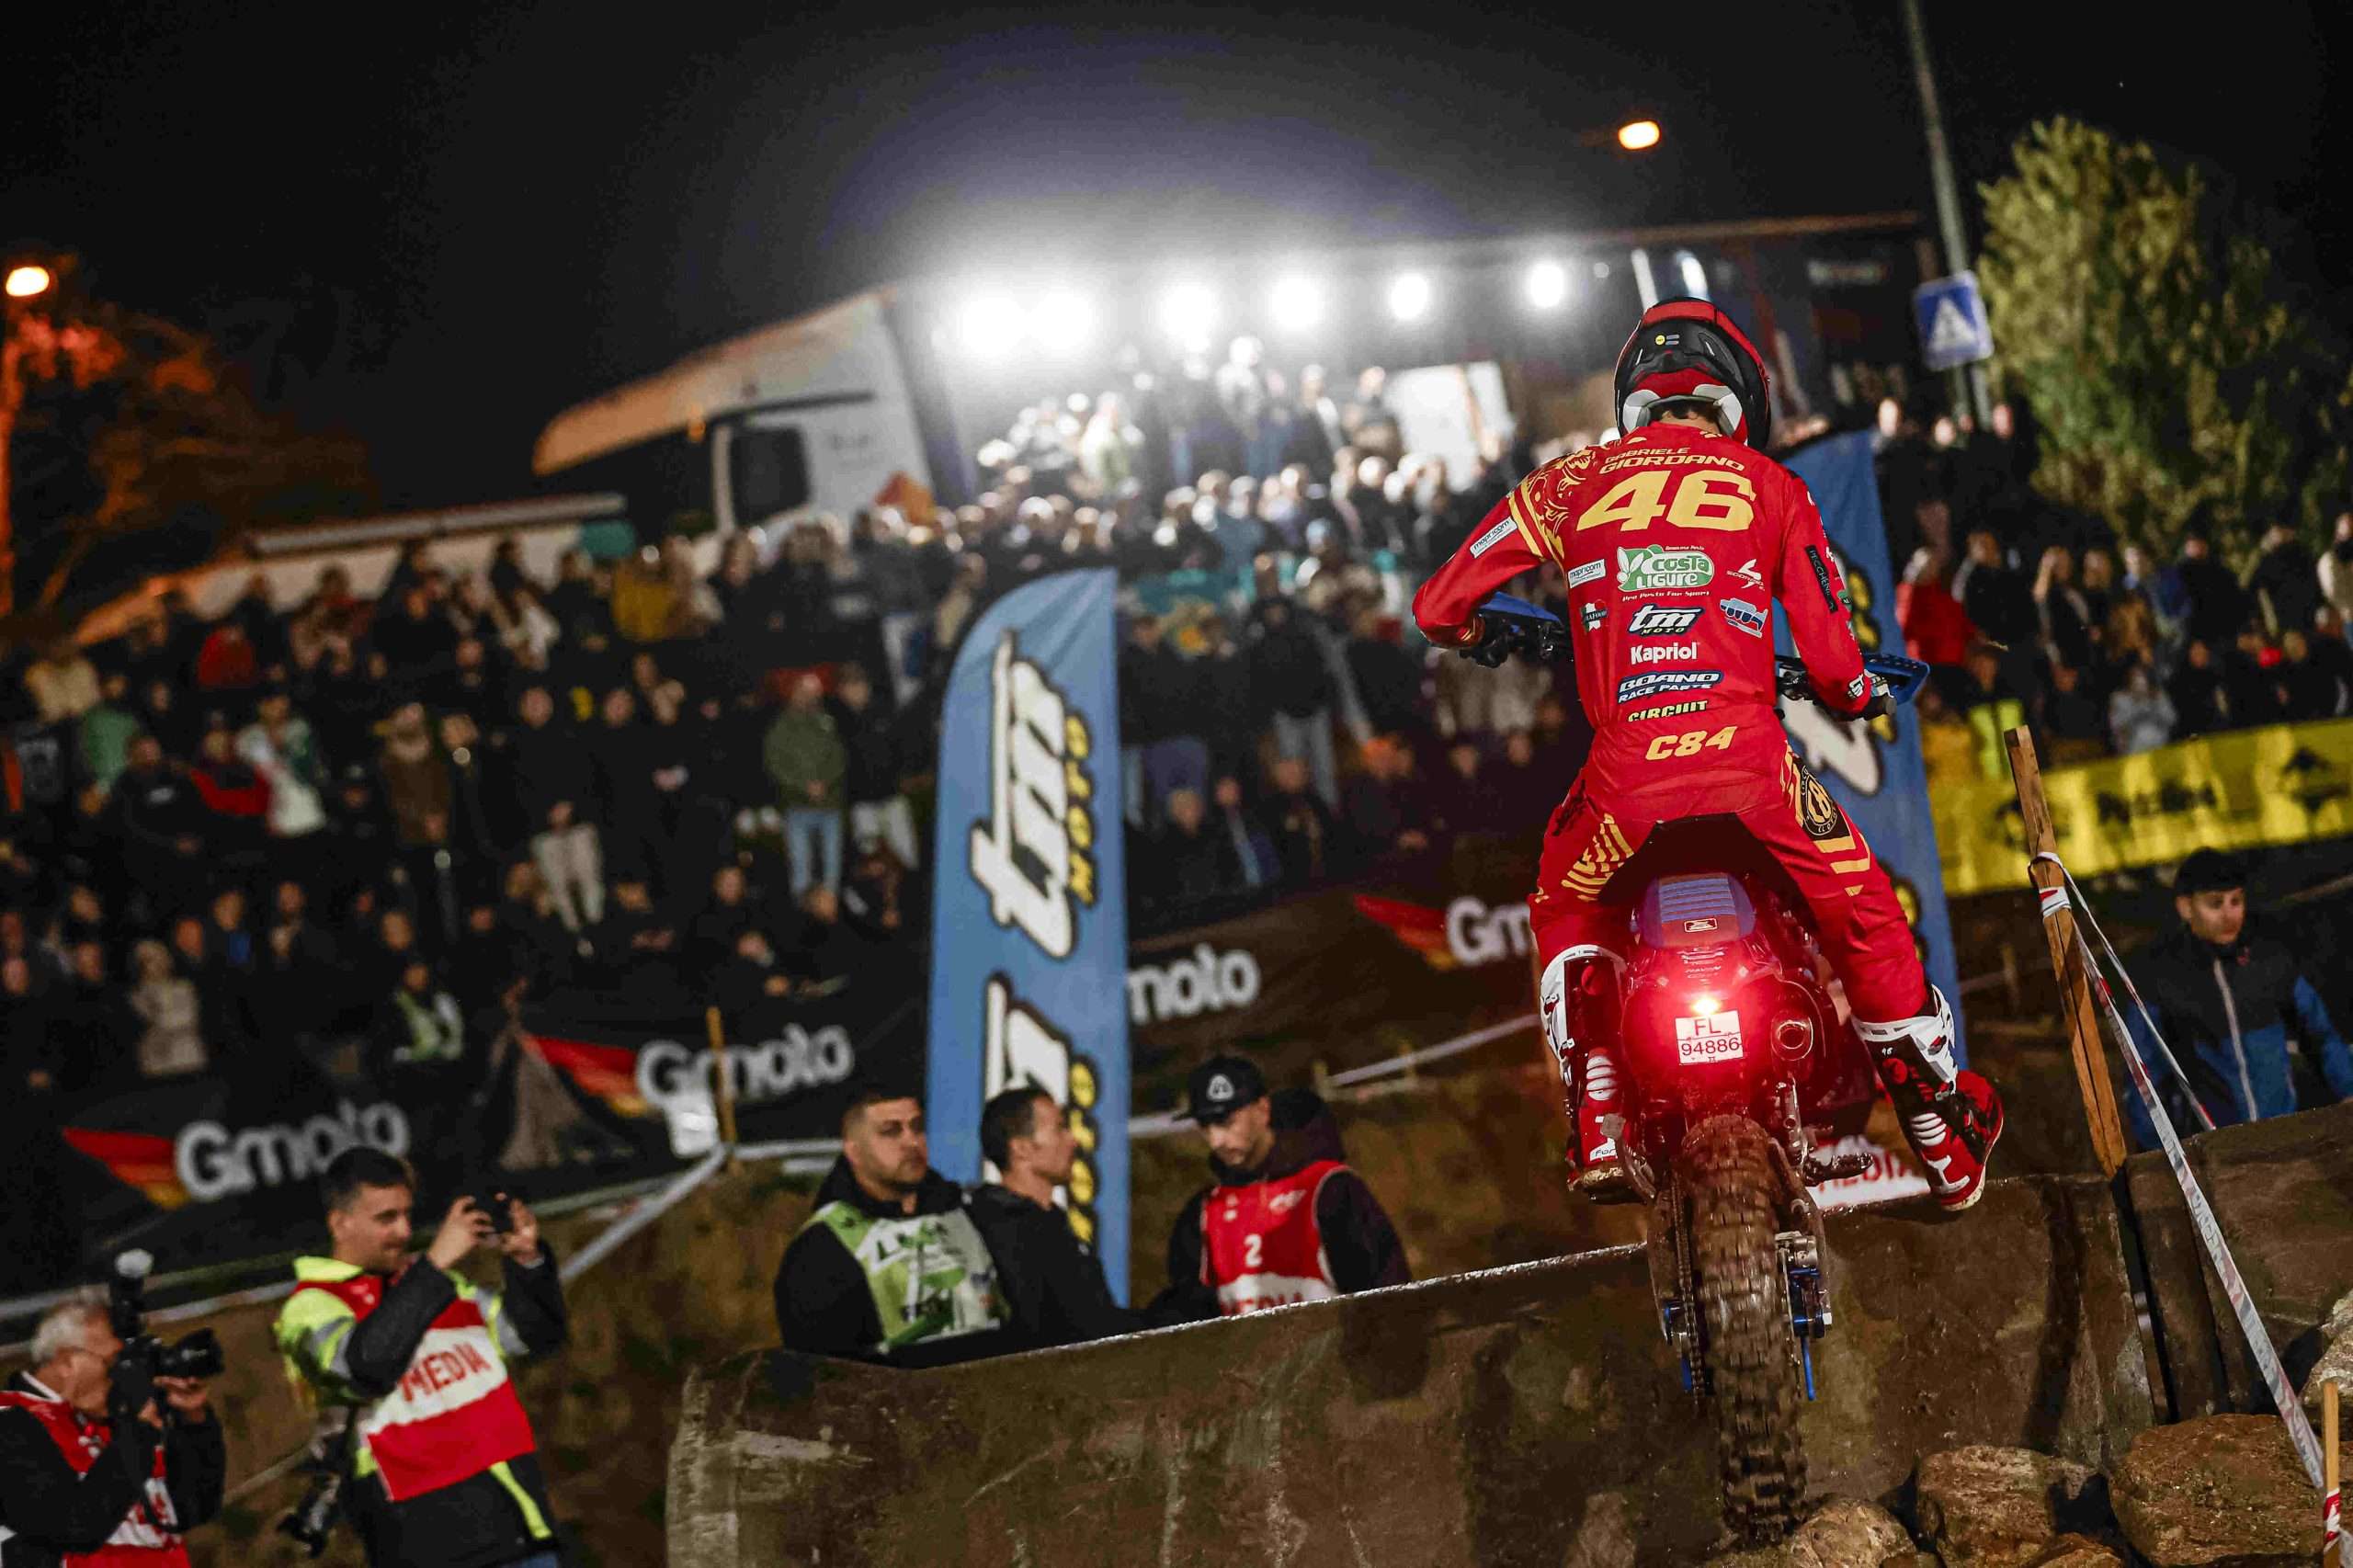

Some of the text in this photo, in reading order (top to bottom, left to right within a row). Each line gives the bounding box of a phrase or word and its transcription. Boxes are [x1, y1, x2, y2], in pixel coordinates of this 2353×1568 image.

[1599, 455, 1745, 474] GIORDANO
[1605, 448, 1691, 463] GABRIELE
[1576, 470, 1756, 532] 46
[1631, 642, 1698, 665] Kapriol
[1620, 673, 1720, 693] BOANO
[1618, 685, 1655, 703] RACE
[1645, 726, 1738, 761] C84
[1693, 1017, 1722, 1036] FL
[1681, 1038, 1740, 1056] 94886
[1245, 1233, 1263, 1268] 2
